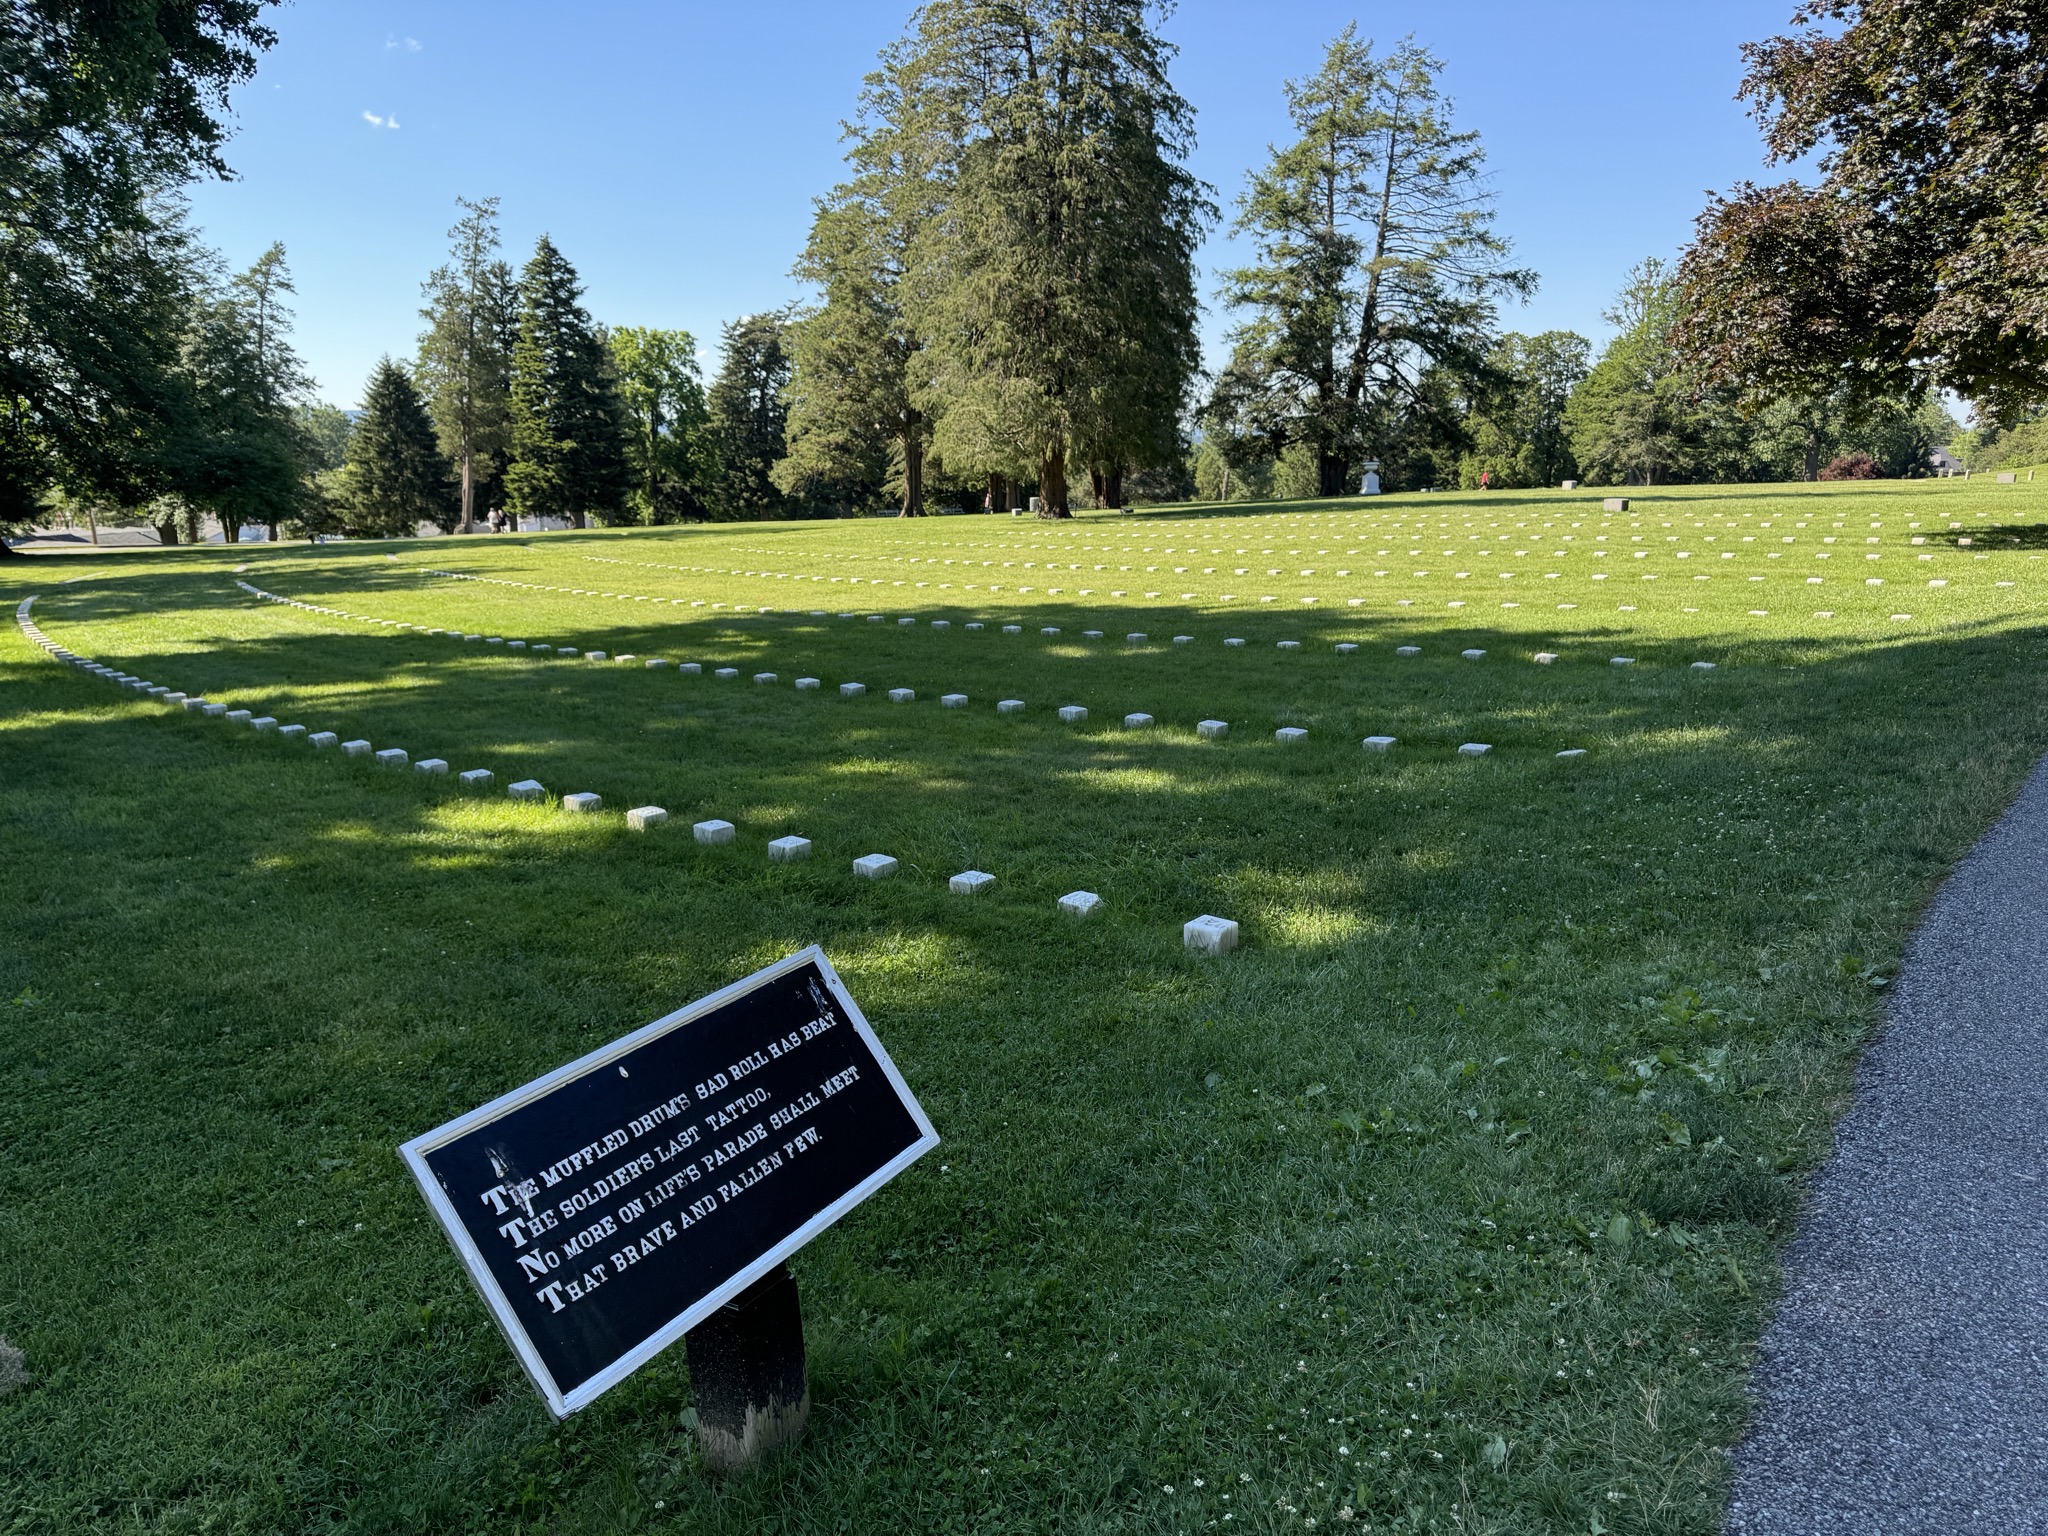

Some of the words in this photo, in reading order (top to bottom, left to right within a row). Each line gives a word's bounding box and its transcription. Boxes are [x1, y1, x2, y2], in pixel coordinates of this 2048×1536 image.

[499, 1209, 558, 1248] THE
[559, 1153, 654, 1218] SOLDIER'S
[654, 1126, 700, 1162] LAST
[705, 1088, 771, 1131] TATTOO,
[517, 1248, 560, 1283] NO
[564, 1216, 617, 1259] MORE
[619, 1198, 645, 1223] ON
[645, 1164, 701, 1207] LIFE'S
[701, 1123, 767, 1172] PARADE
[770, 1092, 820, 1130] SHALL
[820, 1066, 860, 1098] MEET
[539, 1130, 628, 1187] MUFFLED
[628, 1093, 690, 1137] DRUM'S
[696, 1074, 728, 1099] SAD
[728, 1052, 769, 1080] ROLL
[768, 1032, 801, 1058] HAS
[800, 1012, 836, 1040] BEAT
[536, 1264, 608, 1313] THAT
[610, 1221, 677, 1272] BRAVE
[681, 1195, 717, 1229] AND
[717, 1152, 783, 1202] FALLEN
[783, 1127, 822, 1158] FEW.
